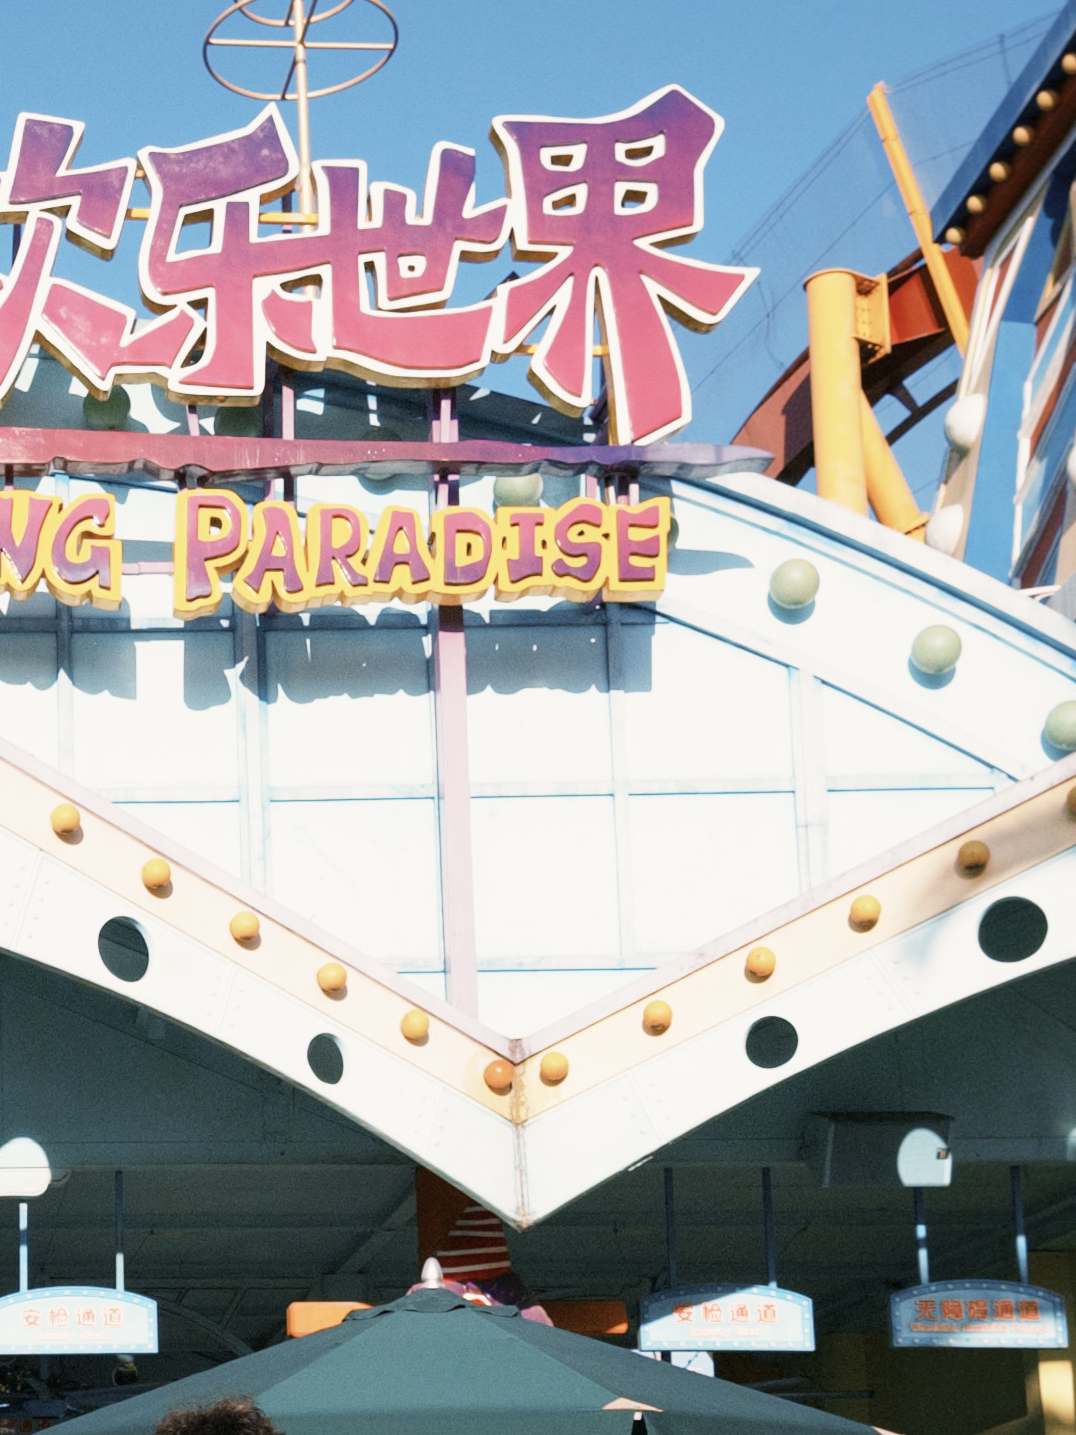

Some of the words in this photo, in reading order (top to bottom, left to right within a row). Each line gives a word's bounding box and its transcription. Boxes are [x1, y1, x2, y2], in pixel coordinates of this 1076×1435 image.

[174, 492, 671, 620] PARADISE
[22, 1307, 123, 1328] 安检通道
[672, 1301, 776, 1324] 安检通道
[915, 1297, 1041, 1321] 无障碍通道
